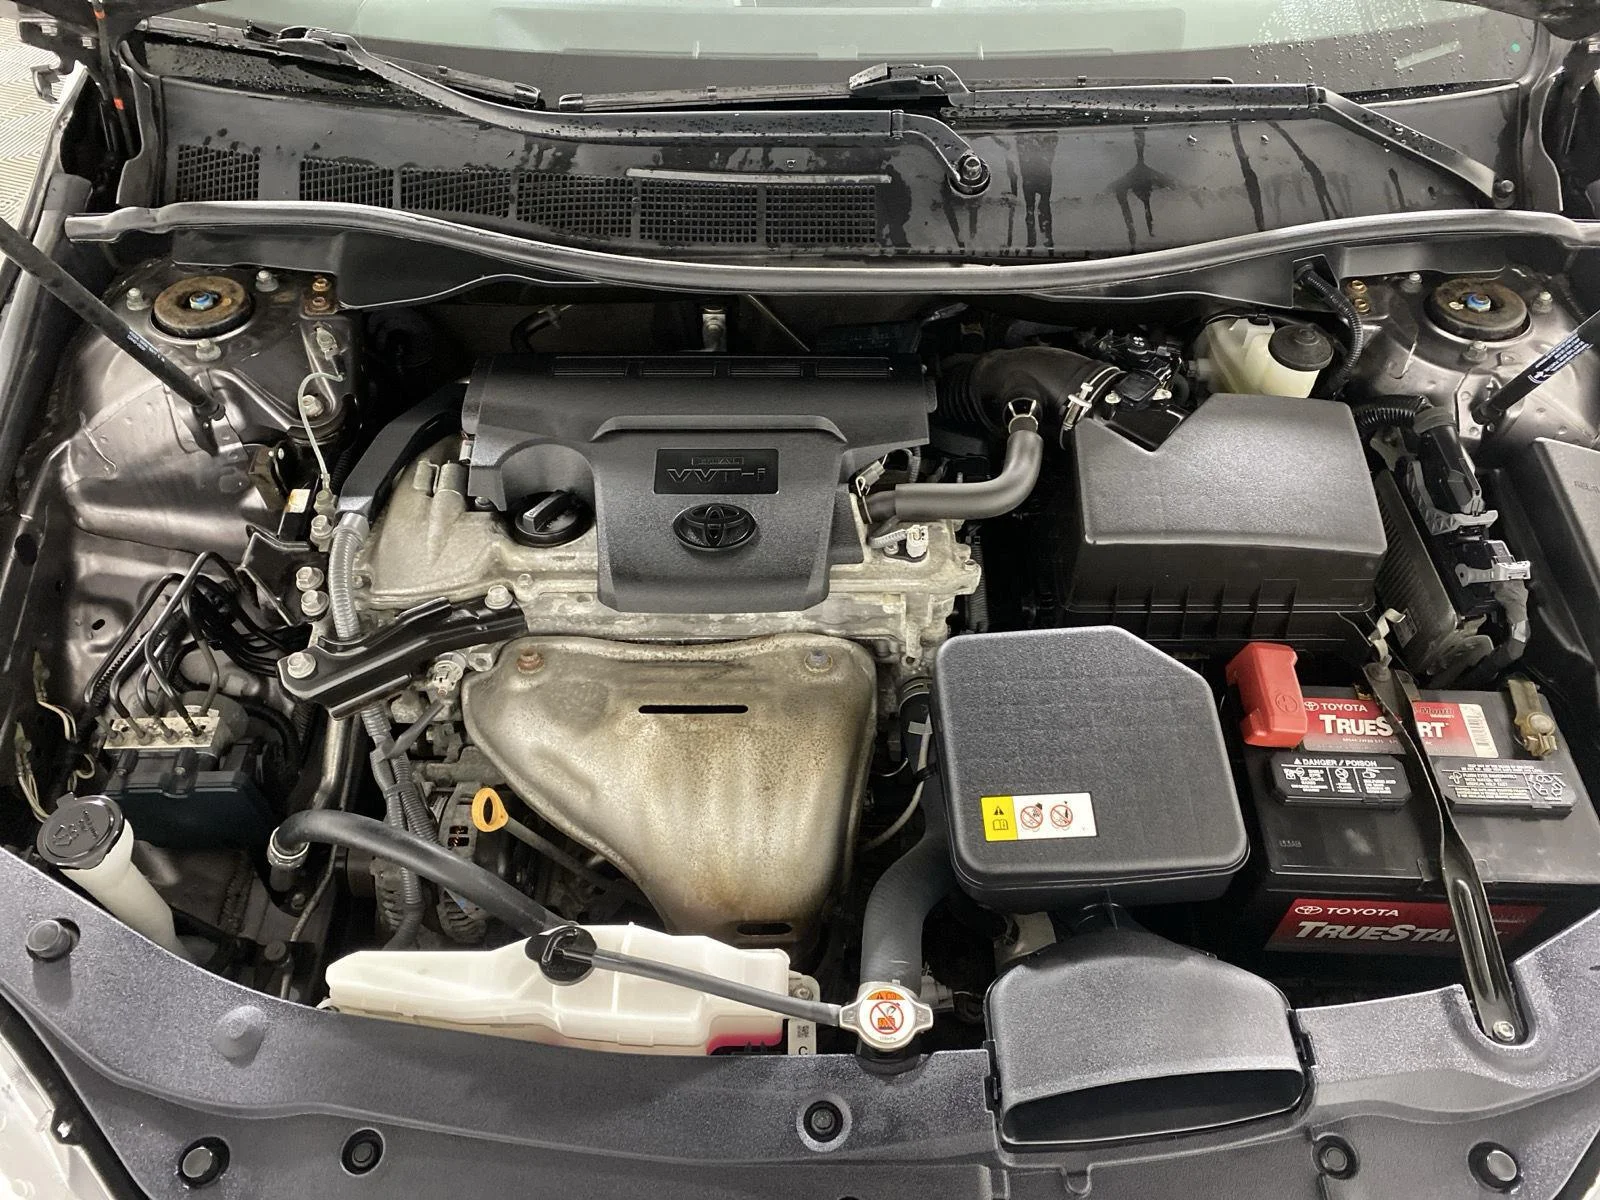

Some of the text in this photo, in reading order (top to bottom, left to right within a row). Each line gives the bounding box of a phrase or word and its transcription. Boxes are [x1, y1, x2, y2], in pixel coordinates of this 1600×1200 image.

[1321, 702, 1368, 712] TOYOTA
[1319, 714, 1446, 738] TRUESRT
[1302, 758, 1338, 766] DANGER
[1346, 759, 1378, 767] POISON
[1327, 907, 1399, 917] TOYOTA
[1295, 921, 1502, 942] TRUESTA
